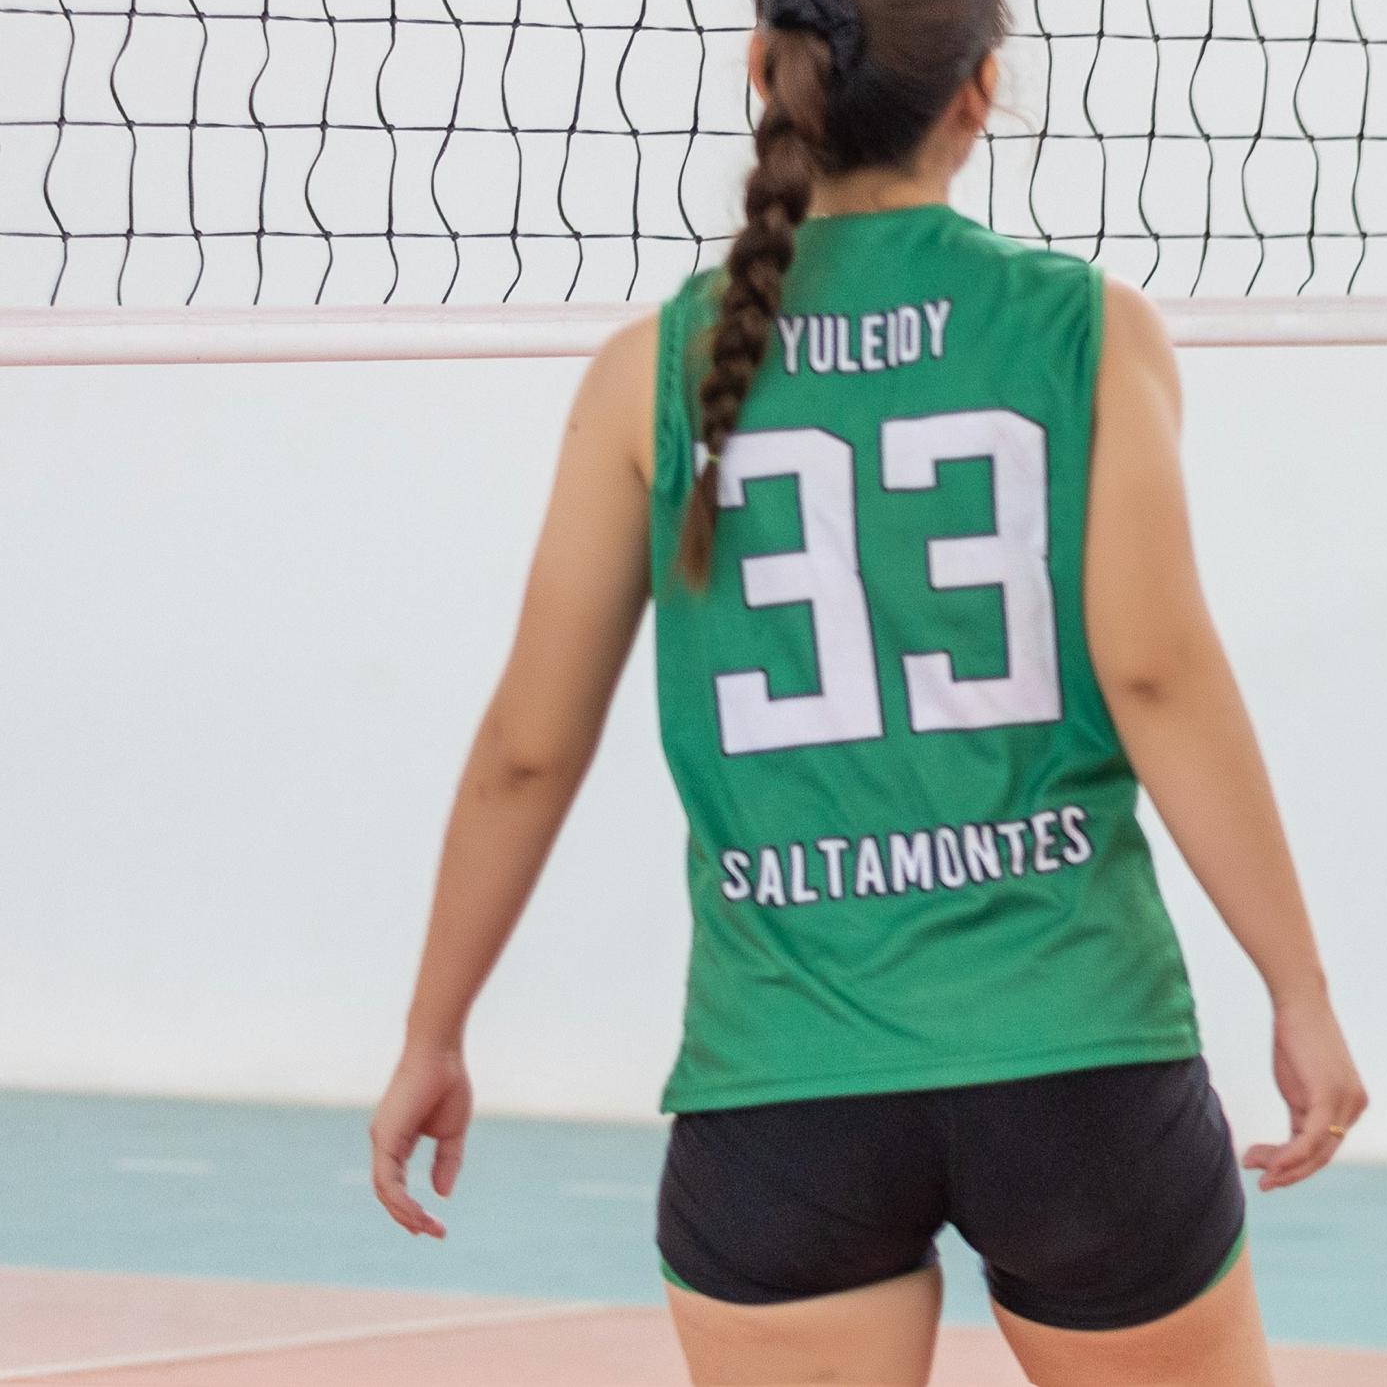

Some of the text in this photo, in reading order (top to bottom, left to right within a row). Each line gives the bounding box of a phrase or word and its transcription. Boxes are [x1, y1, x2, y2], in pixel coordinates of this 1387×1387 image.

[776, 298, 954, 375] YULEIDY
[693, 409, 1064, 757] 33
[719, 805, 1096, 907] SALTAMONTES
